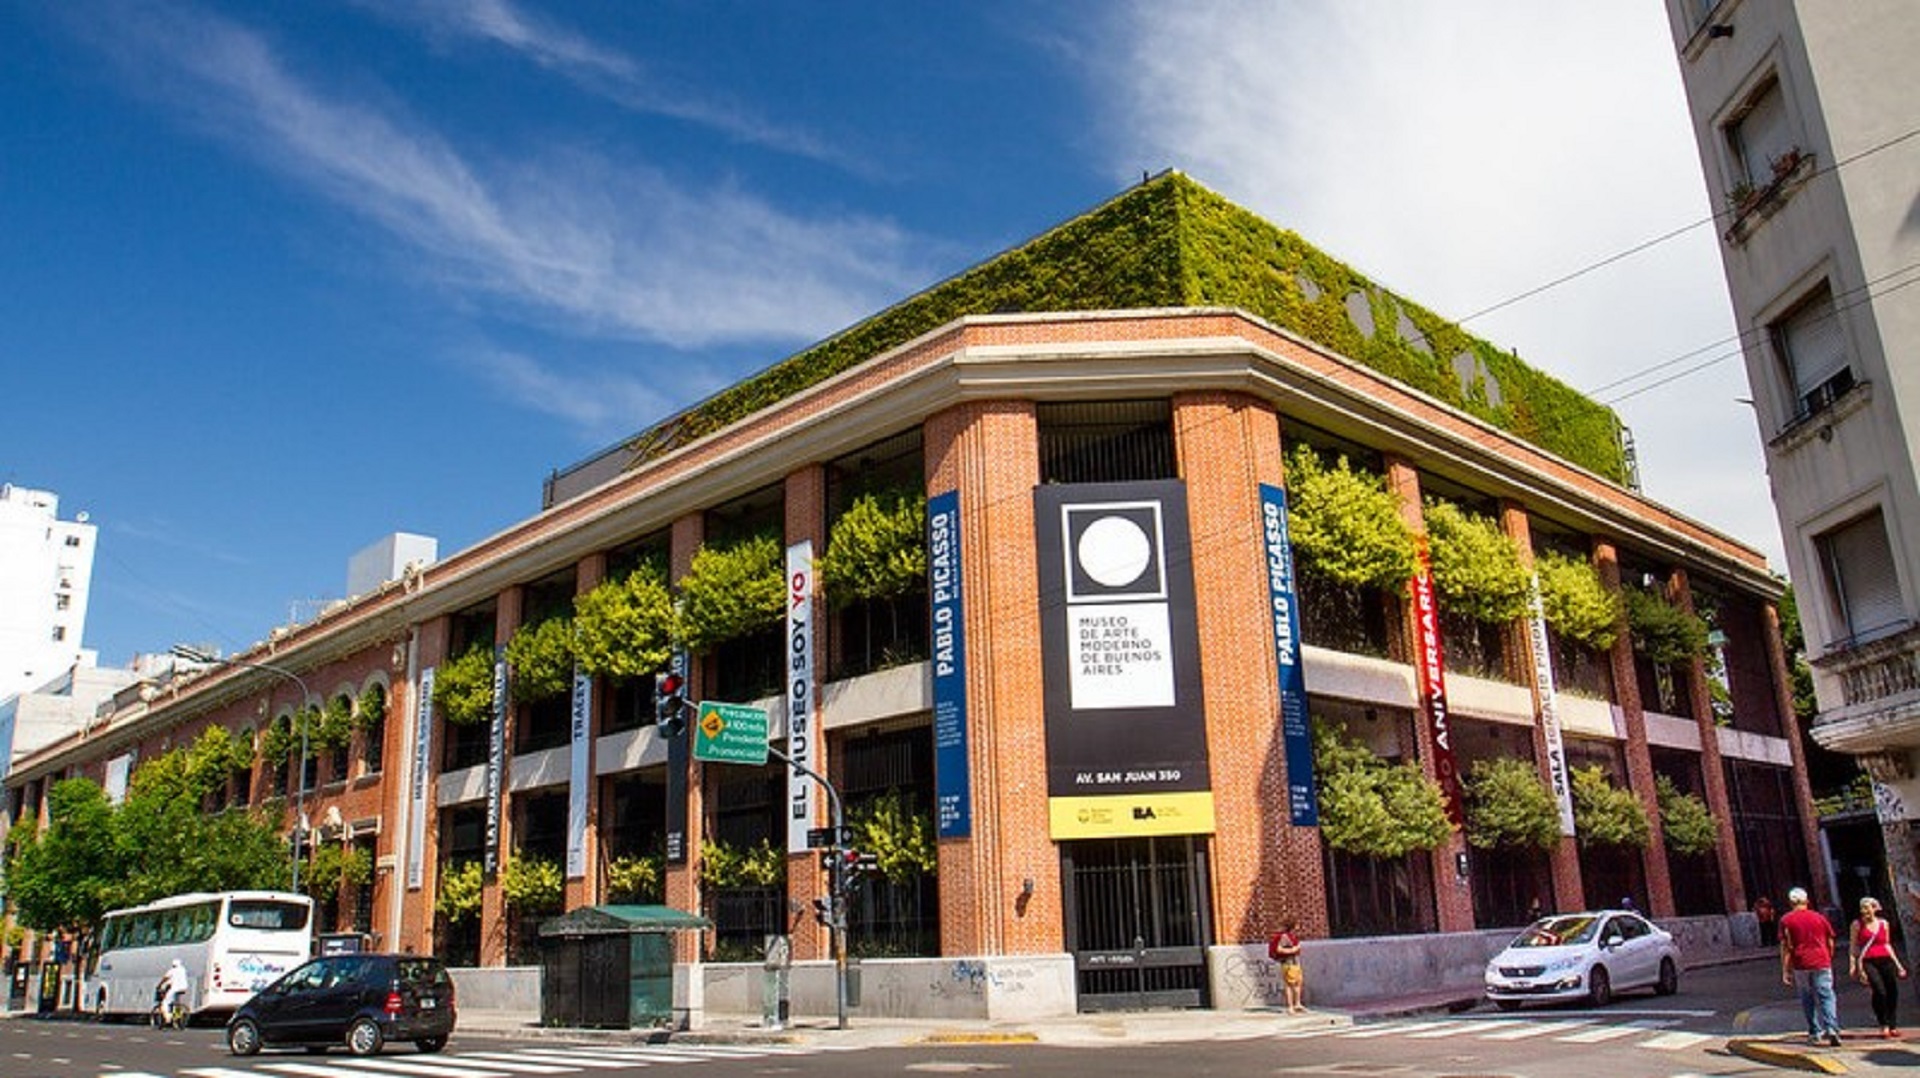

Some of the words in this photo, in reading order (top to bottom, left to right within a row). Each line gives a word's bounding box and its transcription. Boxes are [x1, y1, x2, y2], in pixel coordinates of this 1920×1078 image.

[931, 512, 950, 604] PICASSO
[1263, 502, 1287, 592] PICASSO
[792, 572, 806, 609] YO
[1079, 616, 1128, 627] MUSEO
[1080, 628, 1099, 639] DE
[1103, 627, 1139, 639] ARTE
[1273, 597, 1294, 666] PABLO
[792, 619, 806, 670] SOY
[935, 606, 954, 676] PABLO
[1080, 639, 1152, 651] MODERNO
[1080, 652, 1100, 663] DE
[1104, 651, 1162, 663] BUENOS
[1083, 664, 1123, 675] AIRES
[792, 678, 806, 778] MUSEO
[1076, 772, 1094, 784] AV.
[1096, 772, 1121, 783] SAN
[1124, 770, 1157, 783] JUAN
[1158, 770, 1181, 781] 350
[1550, 750, 1565, 795] SALA
[793, 784, 806, 819] EL
[1133, 806, 1156, 820] BA
